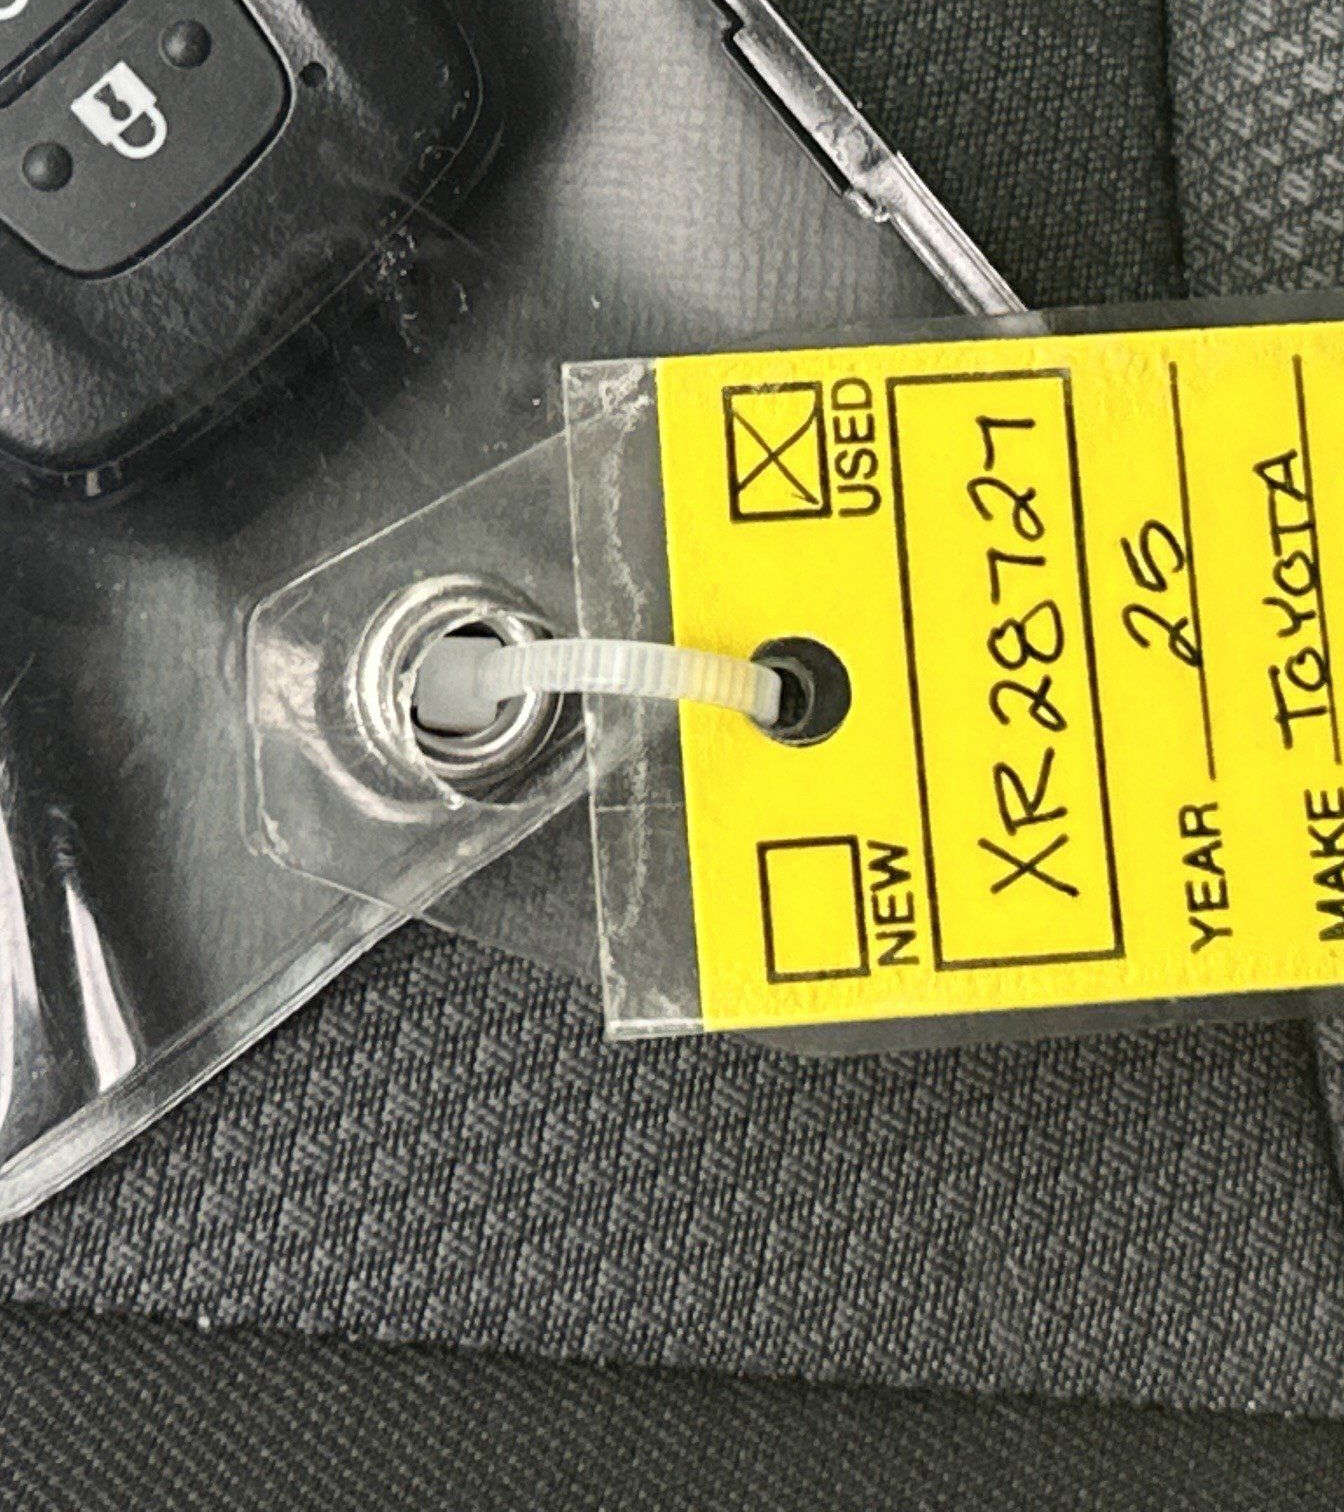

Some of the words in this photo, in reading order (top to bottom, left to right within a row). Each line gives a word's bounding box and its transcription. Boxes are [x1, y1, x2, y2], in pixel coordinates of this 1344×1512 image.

[832, 376, 881, 516] USED
[966, 413, 1080, 897] XR28727
[1119, 518, 1202, 667] 25
[1252, 447, 1331, 748] TOYOTA
[868, 839, 920, 966] NEW
[1179, 800, 1234, 953] YEAR
